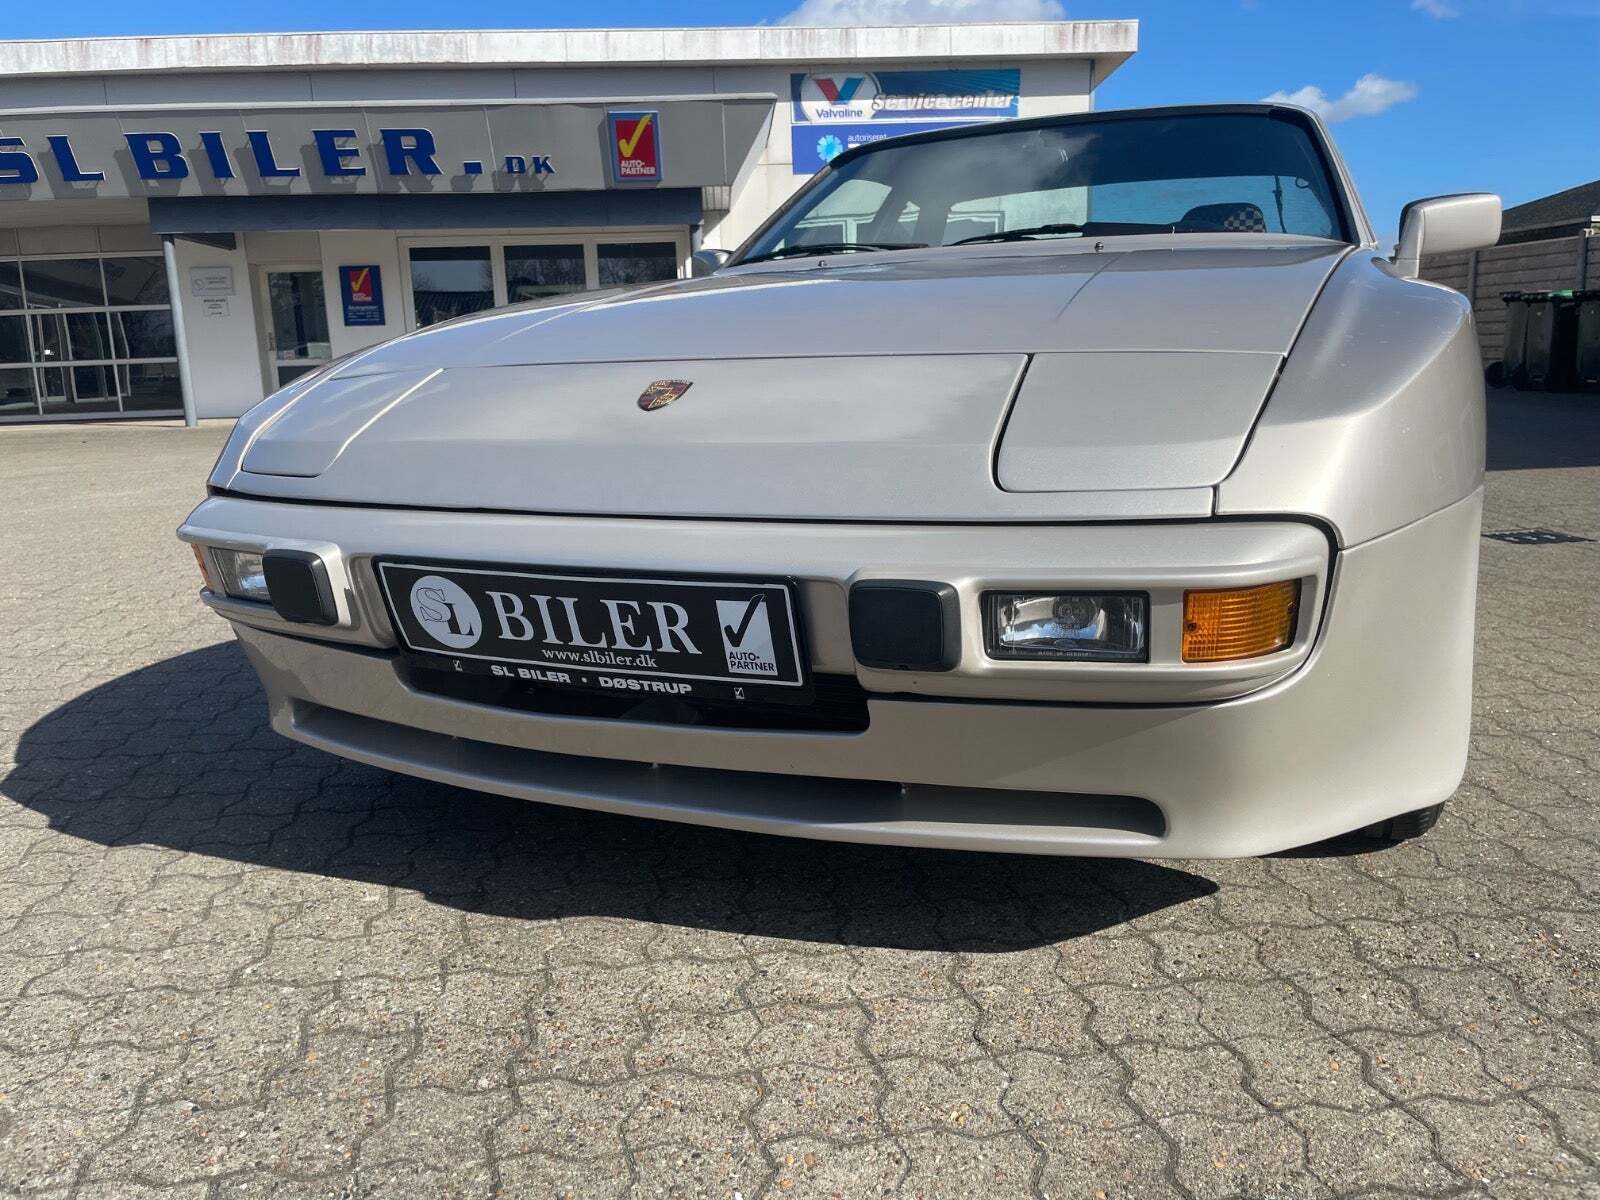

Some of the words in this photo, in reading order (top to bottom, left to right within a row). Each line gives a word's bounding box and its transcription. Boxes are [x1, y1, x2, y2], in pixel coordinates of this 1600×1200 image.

[816, 108, 863, 118] Valvoline
[0, 135, 105, 184] SL
[621, 160, 645, 168] AUTO-
[621, 167, 656, 175] PARTNER
[416, 587, 475, 637] SL
[485, 591, 702, 654] BILER
[542, 649, 658, 667] www.slbiler.dk
[729, 652, 760, 661] AUTO-
[730, 661, 775, 671] PARTNER
[490, 665, 514, 677] SL
[517, 668, 572, 683] BILER
[599, 676, 692, 694] DØSTRUP
